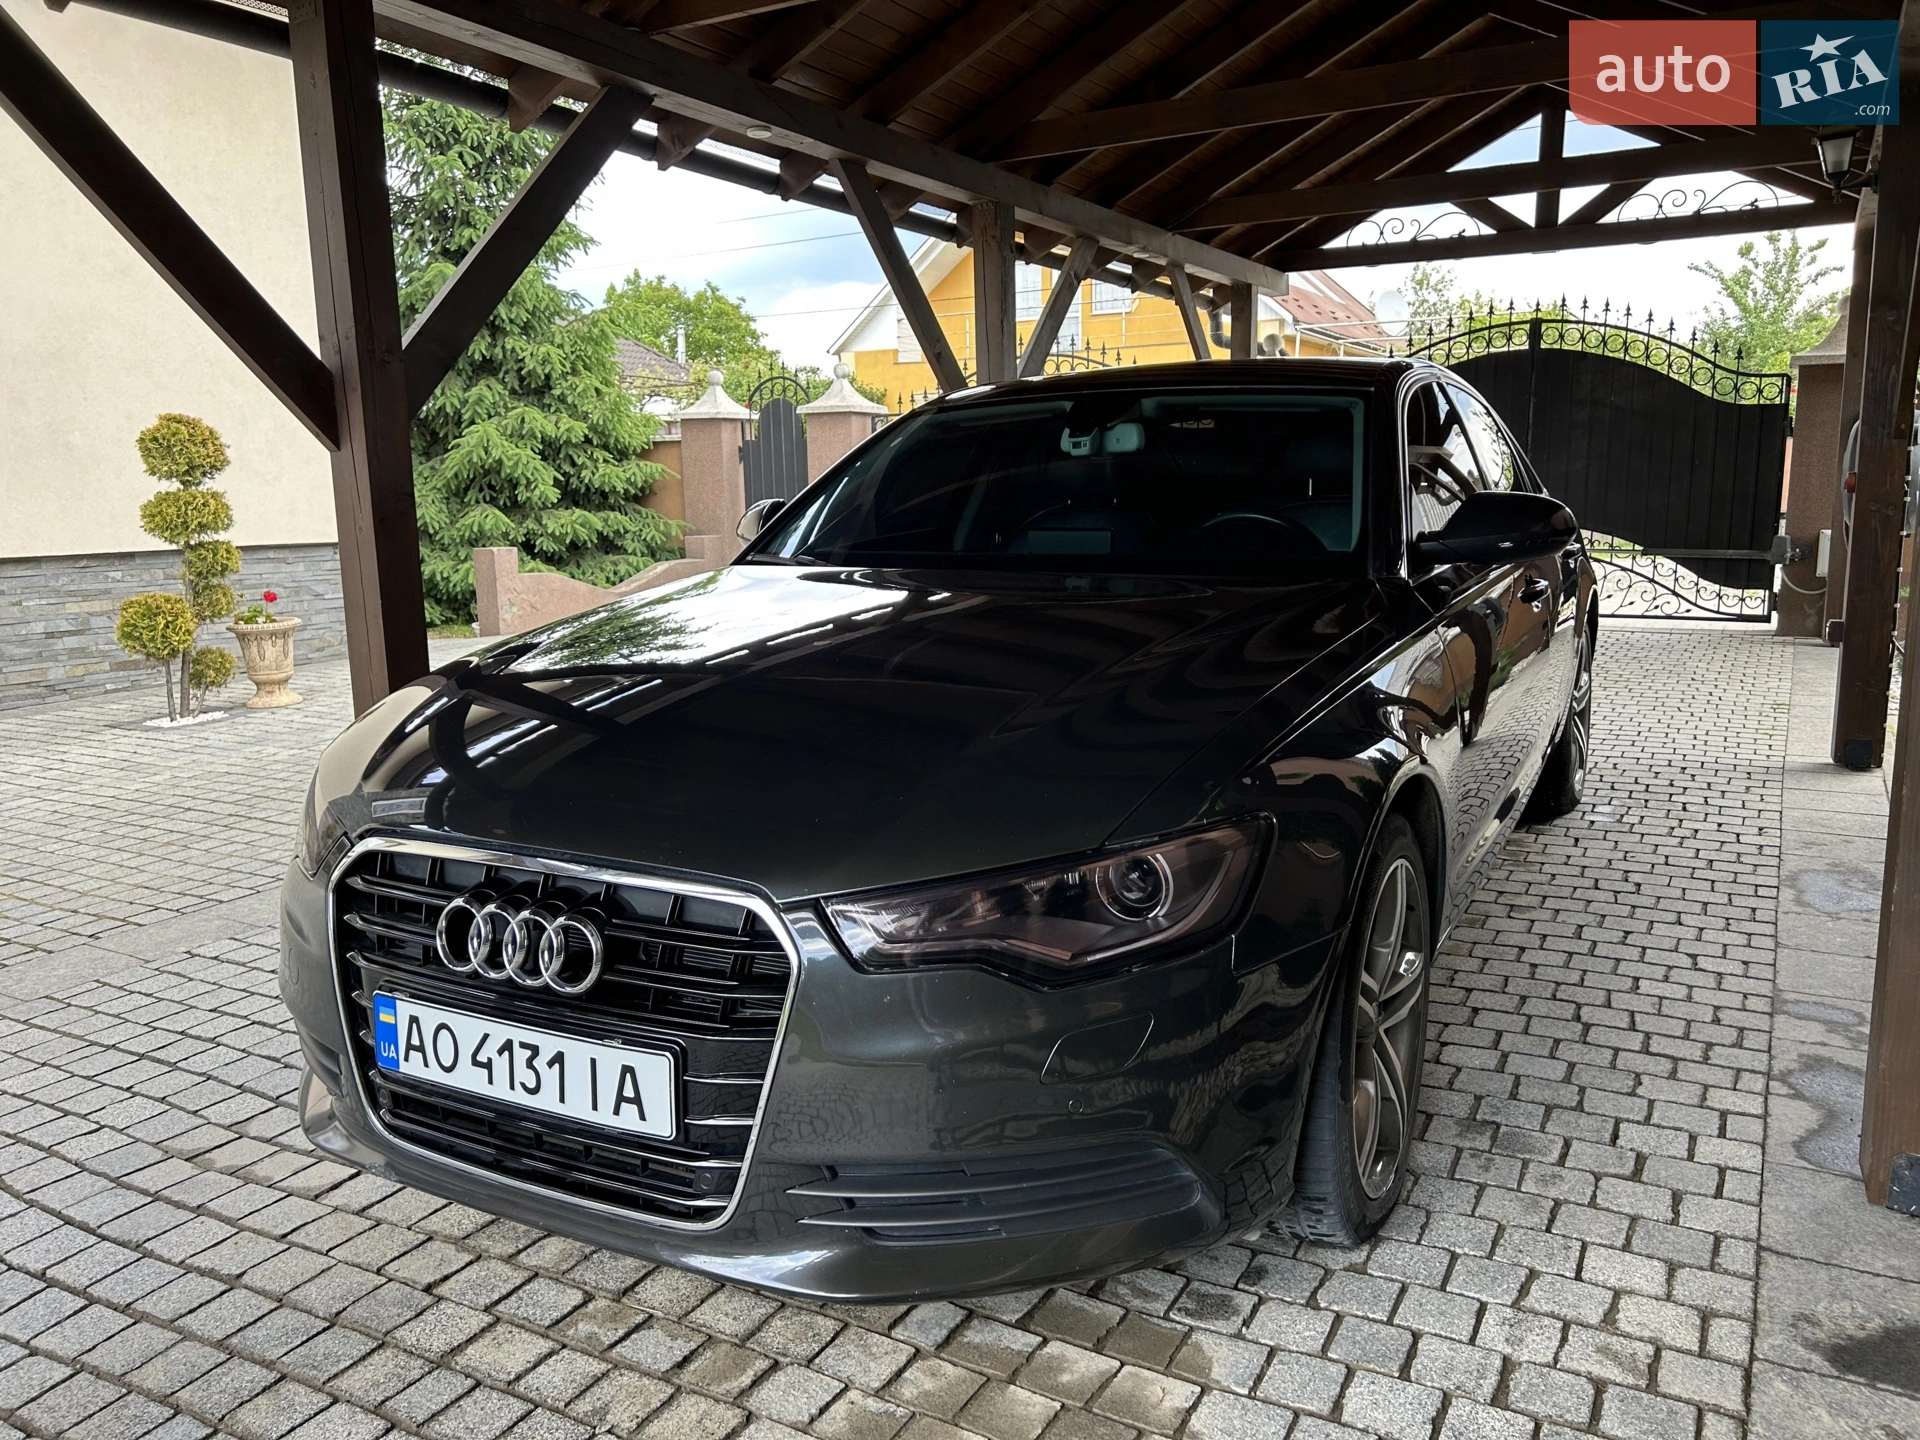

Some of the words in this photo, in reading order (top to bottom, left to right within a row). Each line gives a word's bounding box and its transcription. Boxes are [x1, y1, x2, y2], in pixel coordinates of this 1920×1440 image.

[380, 1041, 398, 1061] UA
[403, 1013, 459, 1074] AO
[470, 1032, 566, 1105] 4131
[589, 1056, 647, 1122] IA
